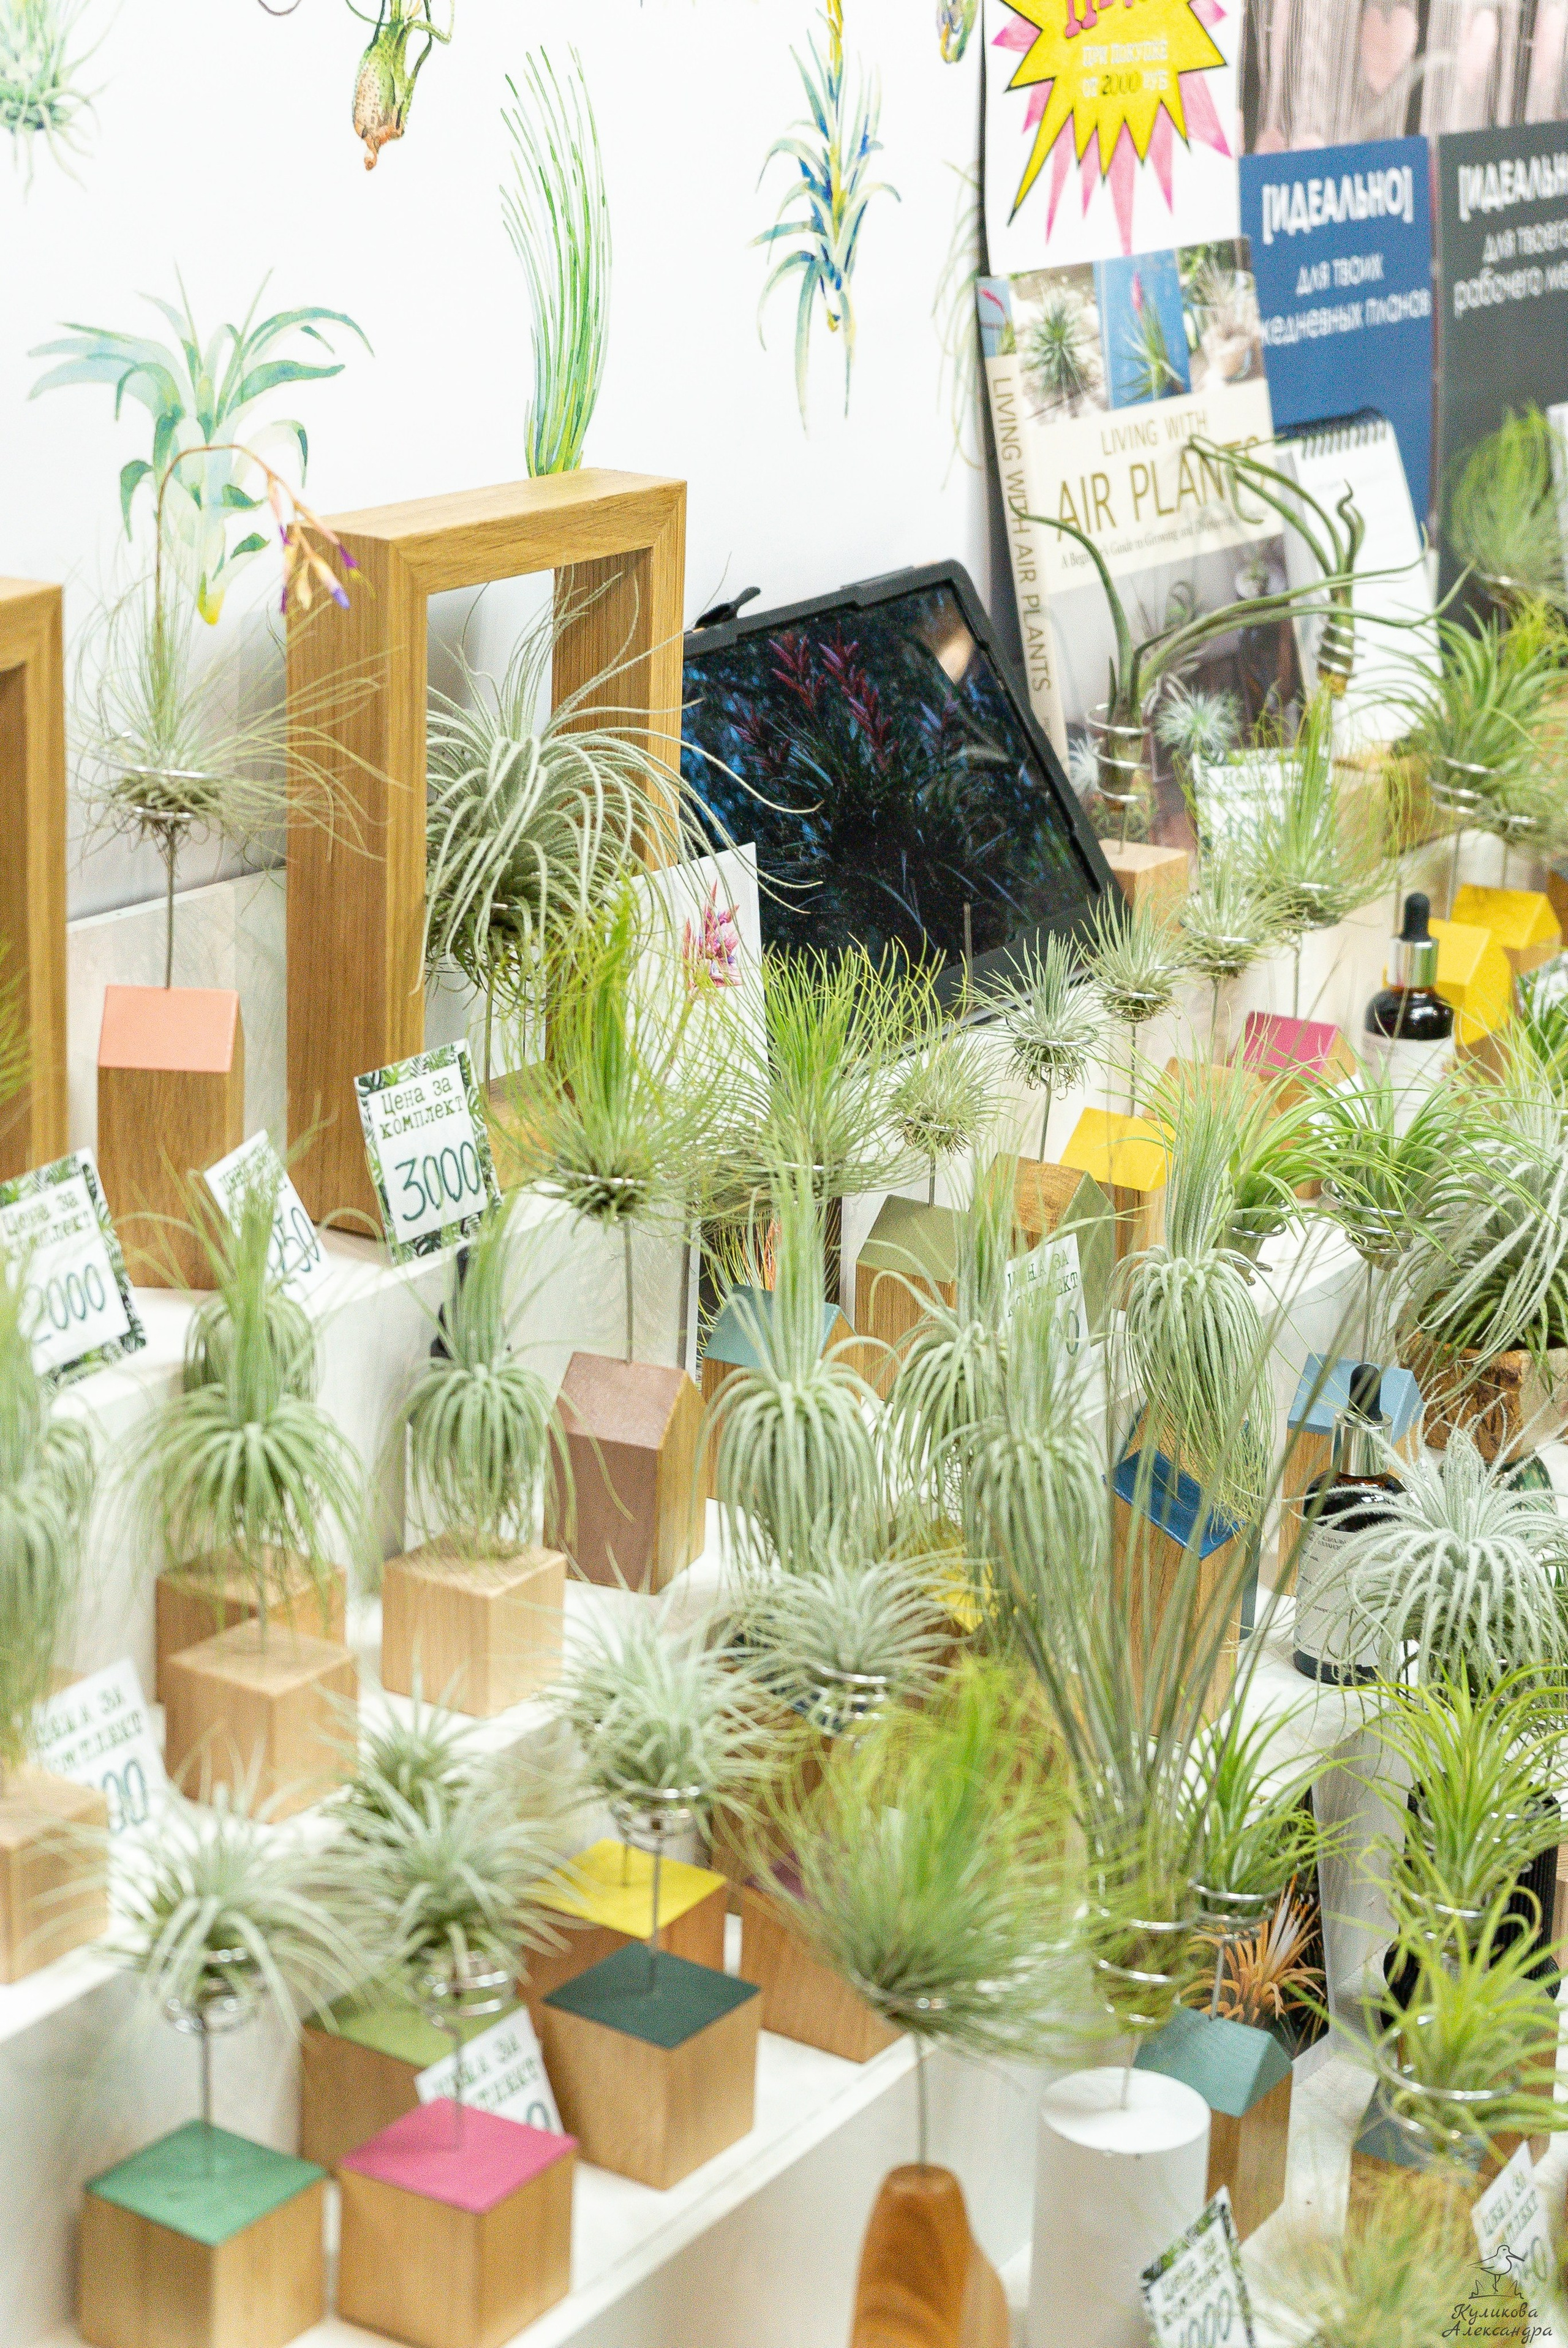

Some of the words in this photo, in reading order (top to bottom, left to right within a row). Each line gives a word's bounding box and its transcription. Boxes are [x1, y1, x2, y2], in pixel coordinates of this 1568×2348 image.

[1453, 266, 1544, 319] рабочего
[993, 377, 1023, 463] LIVING
[1101, 418, 1159, 456] LIVING
[1164, 409, 1210, 441] WITH
[1006, 470, 1035, 535] WITH
[1057, 472, 1118, 542] AIR
[1014, 544, 1038, 585] AIR
[1020, 593, 1052, 693] PLANTS
[379, 1095, 464, 1141] комплект
[380, 1087, 427, 1116] Цена
[432, 1076, 453, 1097] за
[394, 1141, 482, 1221] 3000
